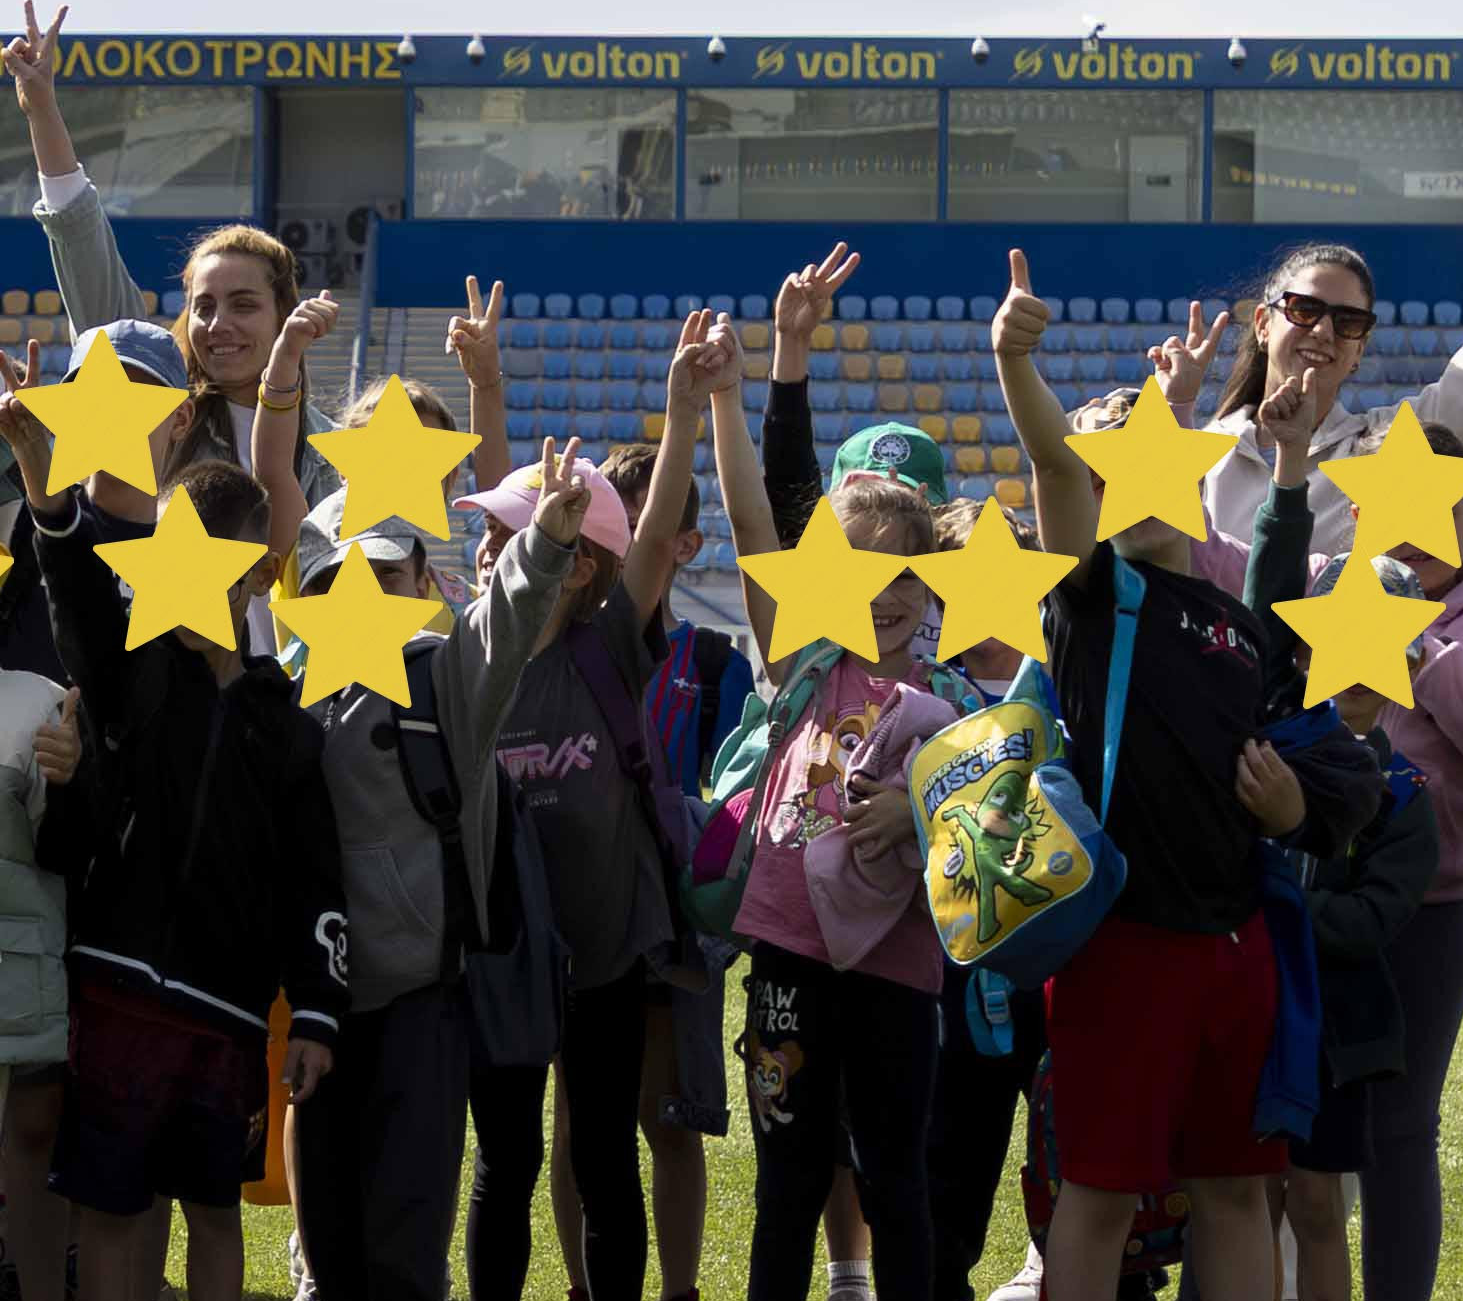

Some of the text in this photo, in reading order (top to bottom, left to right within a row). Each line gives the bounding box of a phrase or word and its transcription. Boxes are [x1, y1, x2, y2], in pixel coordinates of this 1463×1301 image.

[542, 43, 680, 79] volton
[797, 43, 936, 79] volton
[1052, 43, 1192, 80] volton
[1309, 43, 1449, 80] volton
[923, 727, 1034, 822] MUSCLES!
